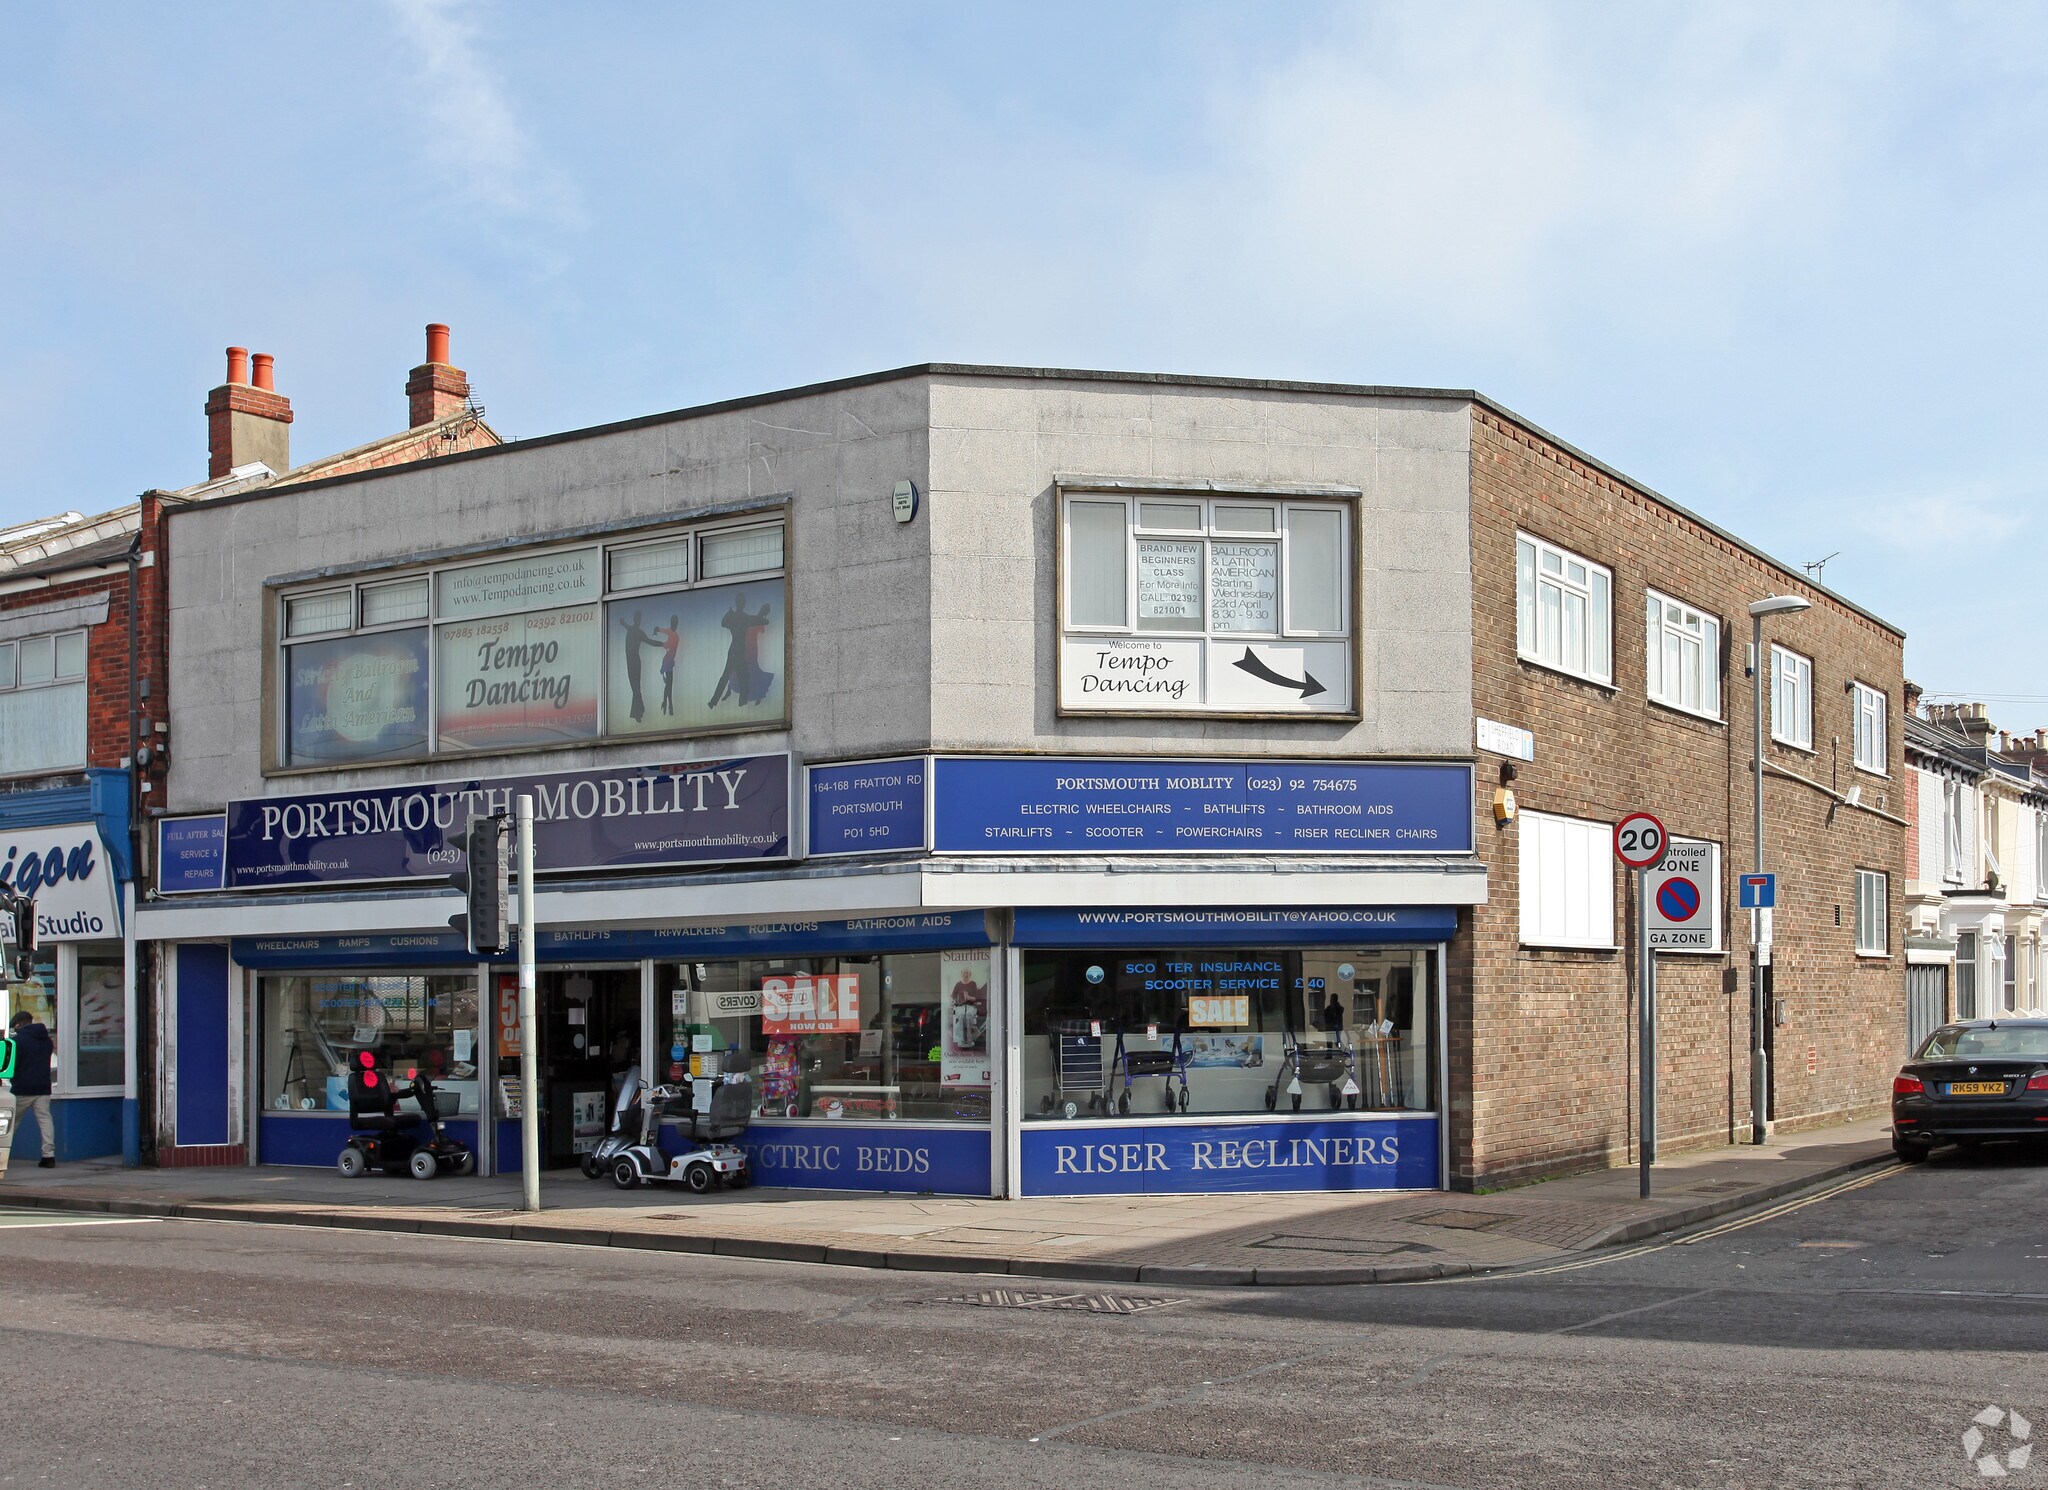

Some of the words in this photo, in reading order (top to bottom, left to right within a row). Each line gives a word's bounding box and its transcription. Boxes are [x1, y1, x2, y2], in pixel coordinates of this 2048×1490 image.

[1140, 544, 1173, 553] BRAND
[1176, 545, 1197, 554] NEW
[1211, 546, 1275, 557] BALLROOM
[1141, 556, 1196, 565] BEGINNERS
[1211, 557, 1220, 567] &
[1222, 557, 1256, 567] LATIN
[453, 558, 586, 590] info@tempodancing.co.uk
[1153, 568, 1185, 577] CLASS
[1211, 568, 1275, 578] AMERICAN
[1140, 580, 1154, 589] For
[1157, 580, 1180, 589] More
[1182, 581, 1199, 590] Info
[1211, 578, 1253, 589] Starting
[453, 575, 587, 606] www.Tempodancing.co.uk
[1212, 588, 1275, 600] Wednesday
[1170, 593, 1198, 603] 02392
[1153, 606, 1186, 615] 821001
[1212, 599, 1237, 609] 23rd
[1239, 599, 1262, 611] April
[1212, 609, 1236, 619] 8.30
[1245, 610, 1269, 620] 9.30
[444, 626, 473, 641] 07885
[476, 622, 509, 637] 182558
[527, 616, 556, 630] 02392
[559, 611, 594, 624] 821001
[1212, 621, 1231, 630] pm
[1108, 640, 1151, 650] Welcome
[1152, 640, 1162, 650] to
[477, 636, 559, 677] Tempo
[1096, 650, 1174, 676] Tempo
[353, 655, 420, 679] Ballroom
[341, 681, 377, 704] And
[465, 669, 572, 710] Dancing
[1080, 674, 1191, 700] Dancing
[342, 704, 417, 729] American
[813, 780, 849, 793] 164-168
[854, 776, 902, 790] FRATTON
[906, 774, 922, 785] RD
[1056, 777, 1160, 790] PORTSMOUTH
[1166, 777, 1234, 789] MOBLITY
[1247, 776, 1283, 791] (023)
[1289, 779, 1306, 790] 92
[1312, 778, 1358, 792] 754675
[261, 787, 514, 840] PORTSMOUTH
[534, 769, 748, 823] MOBILITY
[832, 800, 904, 815] PORTSMOUTH
[1021, 804, 1080, 815] ELECTRIC
[1085, 804, 1172, 815] WHEELCHAIRS
[1203, 804, 1266, 814] BATHLIFTS
[1297, 804, 1362, 815] BATHROOM
[1367, 804, 1394, 815] AIDS
[166, 830, 184, 841] FULL
[186, 830, 209, 840] AFTER
[844, 828, 864, 839] PO1
[869, 825, 890, 837] 5HD
[984, 827, 1053, 838] STAIRLIFTS
[1085, 827, 1144, 838] SCOOTER
[1176, 827, 1263, 838] POWERCHAIRS
[1294, 828, 1329, 838] RISER
[1334, 828, 1391, 839] RECLINER
[1395, 829, 1438, 839] CHAIRS
[634, 831, 779, 851] www.portsmouthmobility.co.uk
[1621, 828, 1659, 852] 20
[180, 849, 210, 859] SERVICE
[213, 848, 218, 858] &
[1667, 847, 1706, 857] ntrolled
[236, 858, 350, 876] www.portsmouthmobility.co.uk
[1657, 860, 1700, 872] ZONE
[184, 869, 215, 879] REPAIRS
[37, 910, 104, 936] Studio
[1077, 911, 1396, 924] WWW.PORTSMOUTHMOBILITY@YAHOO.CO.UK
[554, 930, 611, 941] BATHLIFTS
[748, 921, 818, 934] ROLLATORS
[847, 917, 916, 930] BATHROOM
[921, 915, 952, 927] AIDS
[255, 940, 320, 950] WHEELCHAIRS
[338, 937, 370, 947] RAMPS
[390, 936, 439, 946] CUSHIONS
[1649, 933, 1668, 943] GA
[1671, 933, 1706, 943] ZONE
[943, 948, 991, 962] Stairlifts
[1200, 961, 1283, 973] INSURANCE
[1144, 978, 1213, 991] SCOOTER
[1219, 978, 1280, 990] SERVICE
[762, 977, 859, 1022] SALE
[1192, 998, 1248, 1024] SALE
[789, 1022, 815, 1030] NOW
[817, 1022, 833, 1030] ON
[1952, 1083, 1979, 1093] RK59
[1981, 1083, 2003, 1092] YKZ
[856, 1146, 930, 1174] BEDS
[1054, 1143, 1171, 1174] RISER
[1191, 1136, 1400, 1171] RECLINERS
